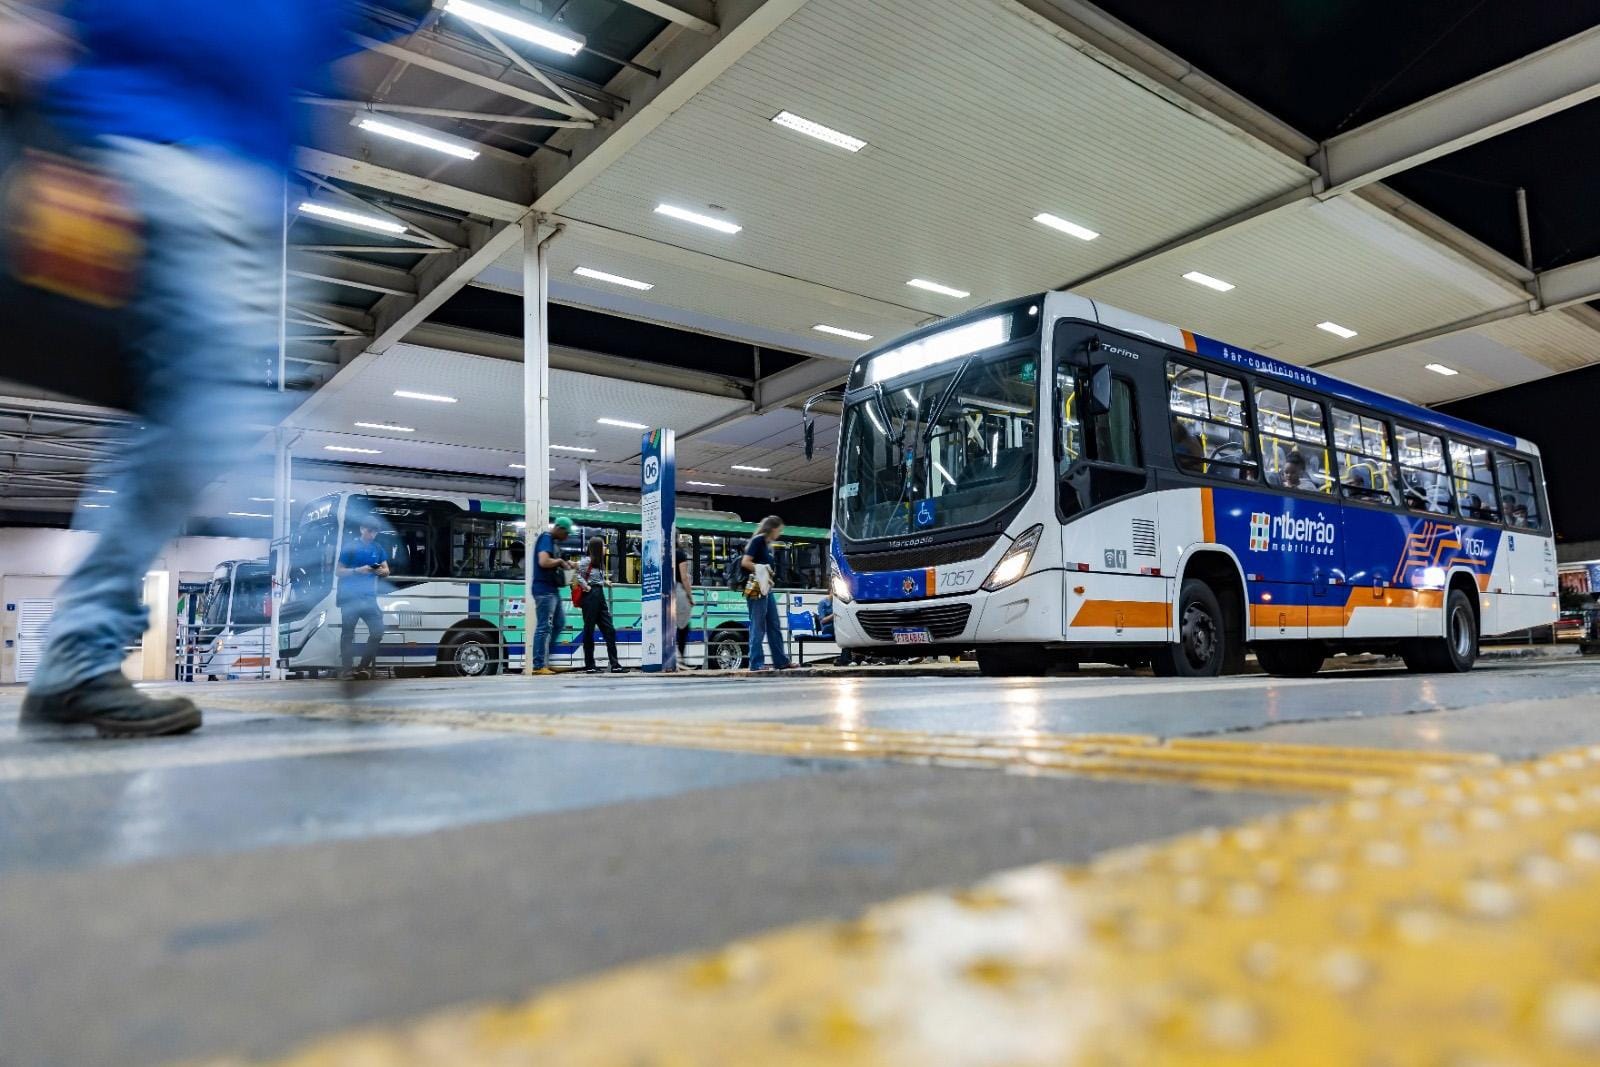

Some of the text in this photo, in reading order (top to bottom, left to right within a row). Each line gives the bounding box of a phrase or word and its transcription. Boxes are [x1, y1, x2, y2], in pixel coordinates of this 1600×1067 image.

[1101, 343, 1139, 360] Torino
[645, 461, 657, 479] 06
[1272, 511, 1335, 544] ribeirão
[888, 536, 934, 548] Marcopolo
[1271, 542, 1334, 556] mobilidade
[1465, 537, 1485, 556] 7057
[940, 569, 975, 587] 7057
